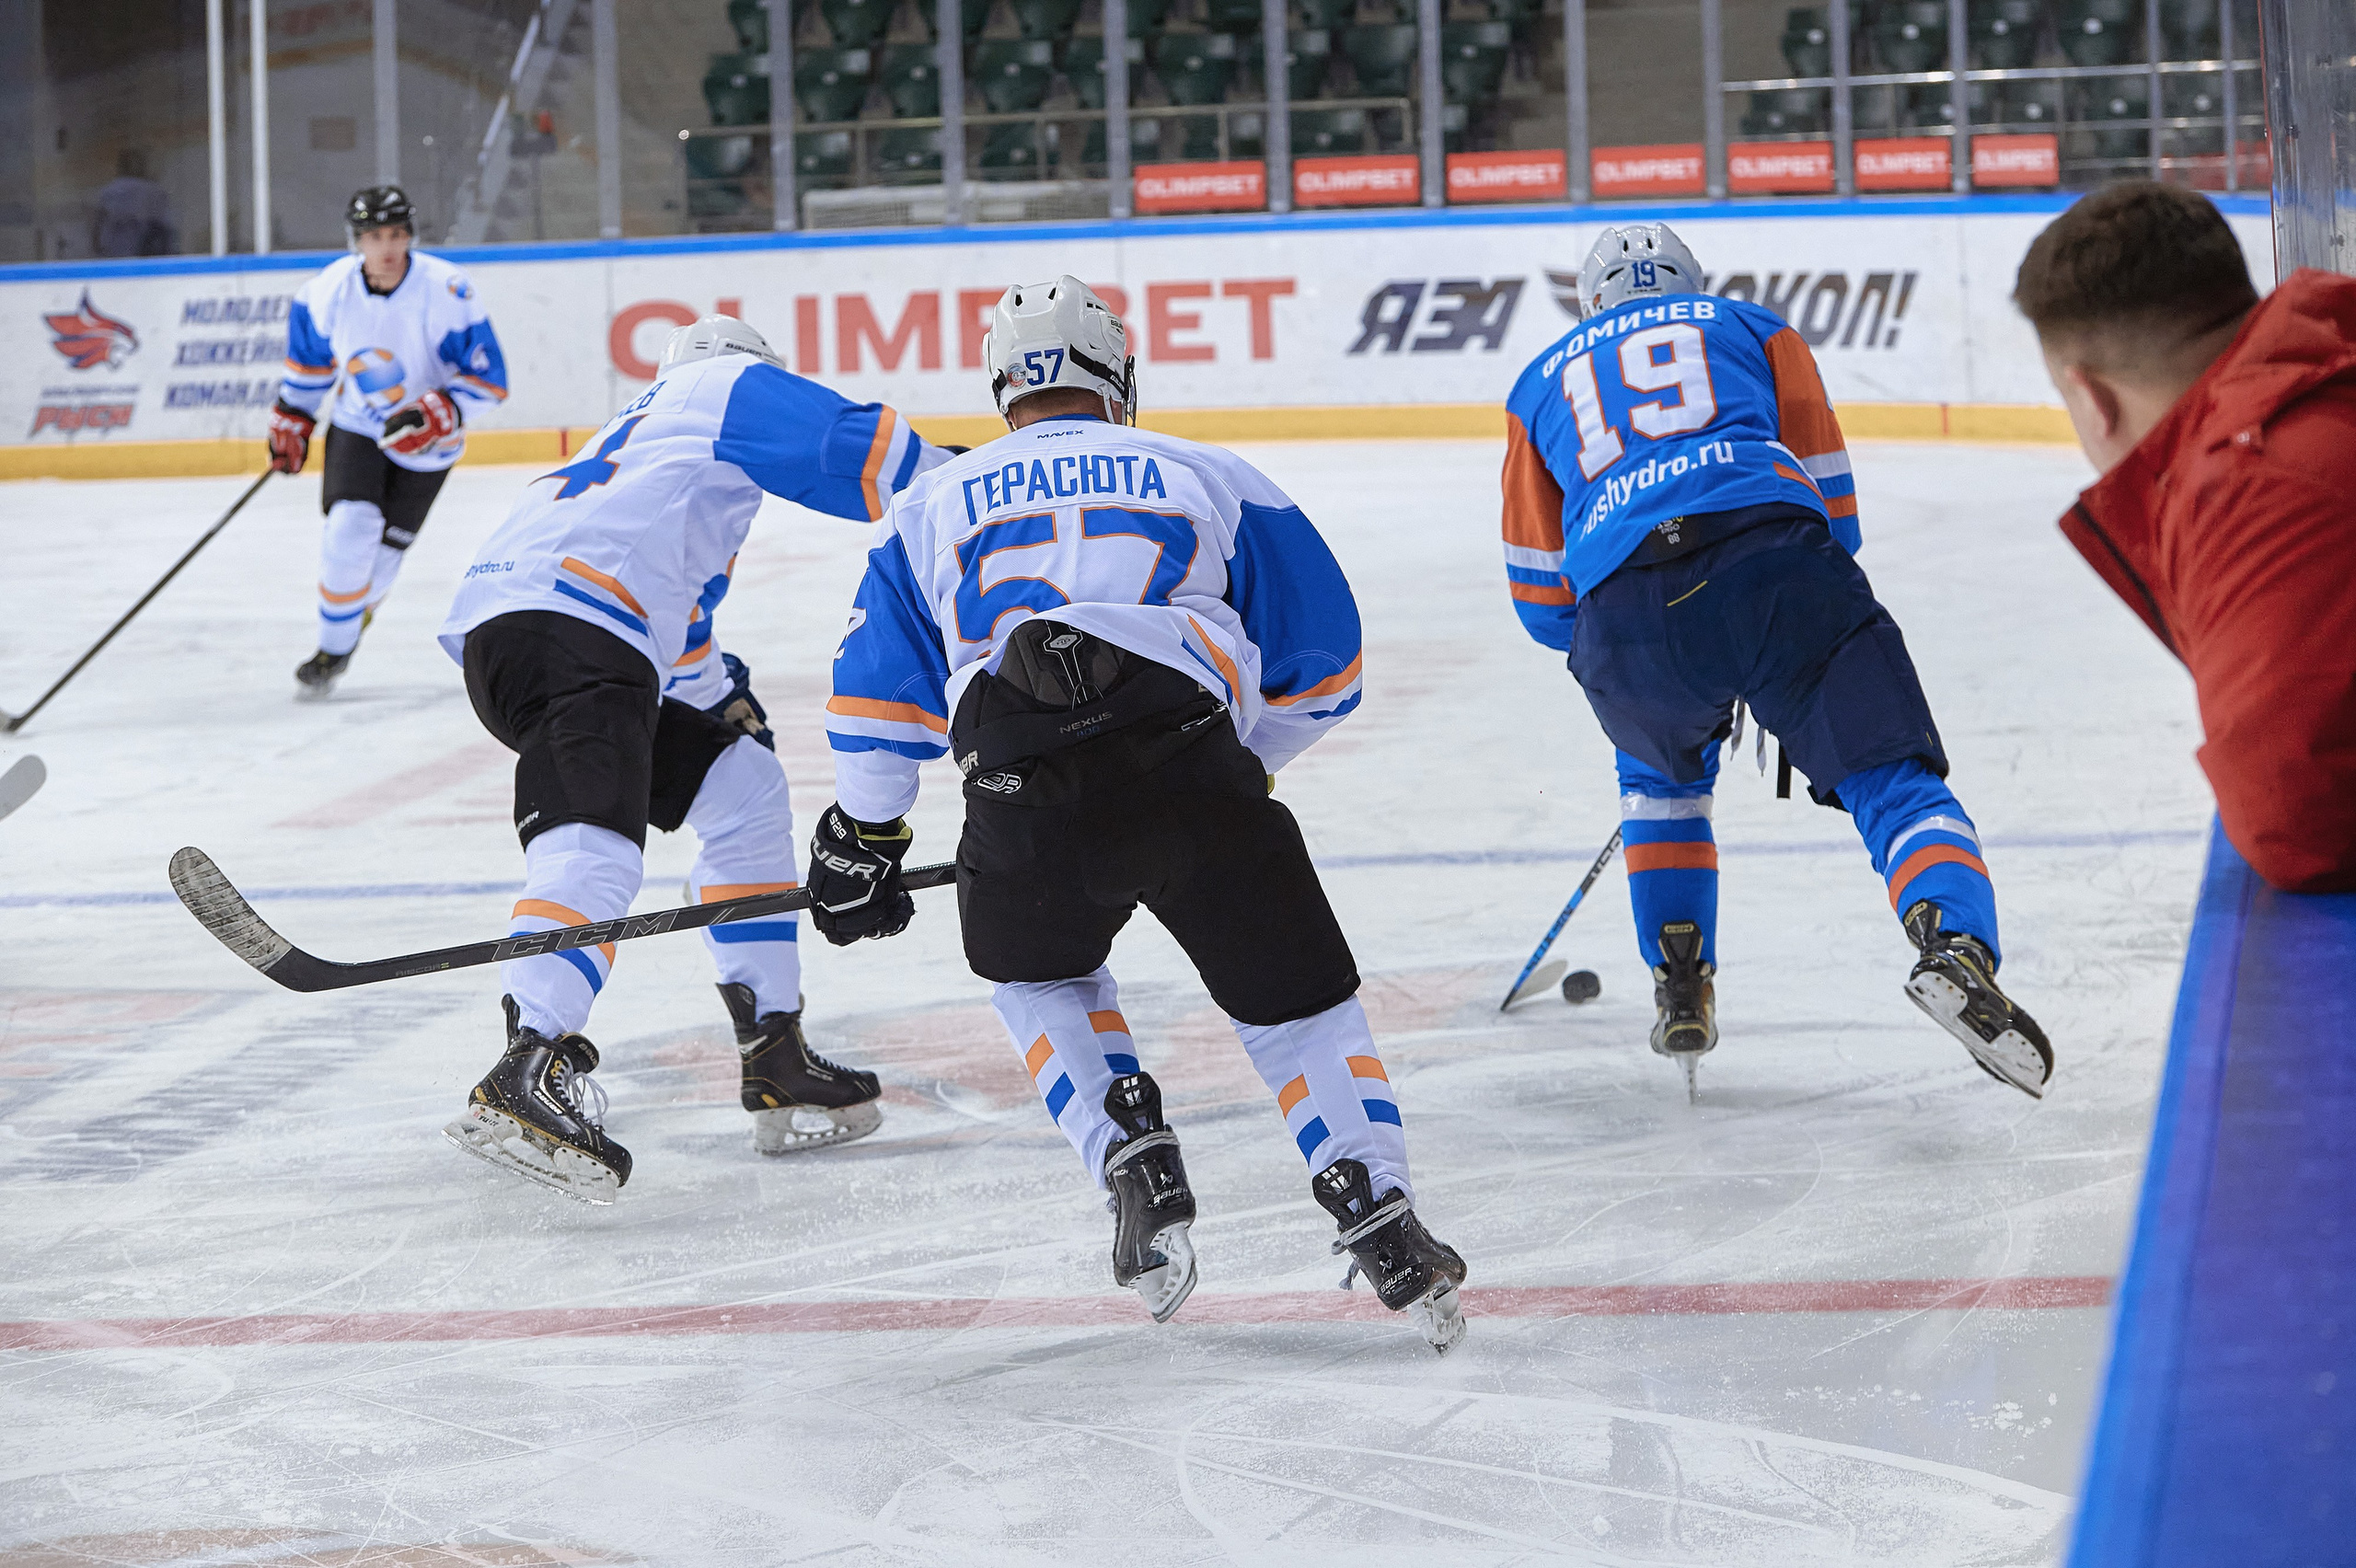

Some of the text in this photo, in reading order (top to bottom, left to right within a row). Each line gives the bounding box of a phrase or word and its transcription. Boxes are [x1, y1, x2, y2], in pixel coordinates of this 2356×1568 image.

[1631, 259, 1657, 288] 19
[1542, 301, 1716, 379] ФОМИЧЕВ
[1023, 347, 1065, 386] 57
[1562, 322, 1718, 483] 19
[1036, 429, 1084, 440] MAVEX
[962, 454, 1167, 526] ГЕРАСЮТА
[953, 505, 1199, 644] 57
[1059, 711, 1113, 734] NEXUS
[828, 812, 848, 840] S29
[491, 909, 679, 963] CCM
[1380, 1266, 1413, 1294] BAUER
